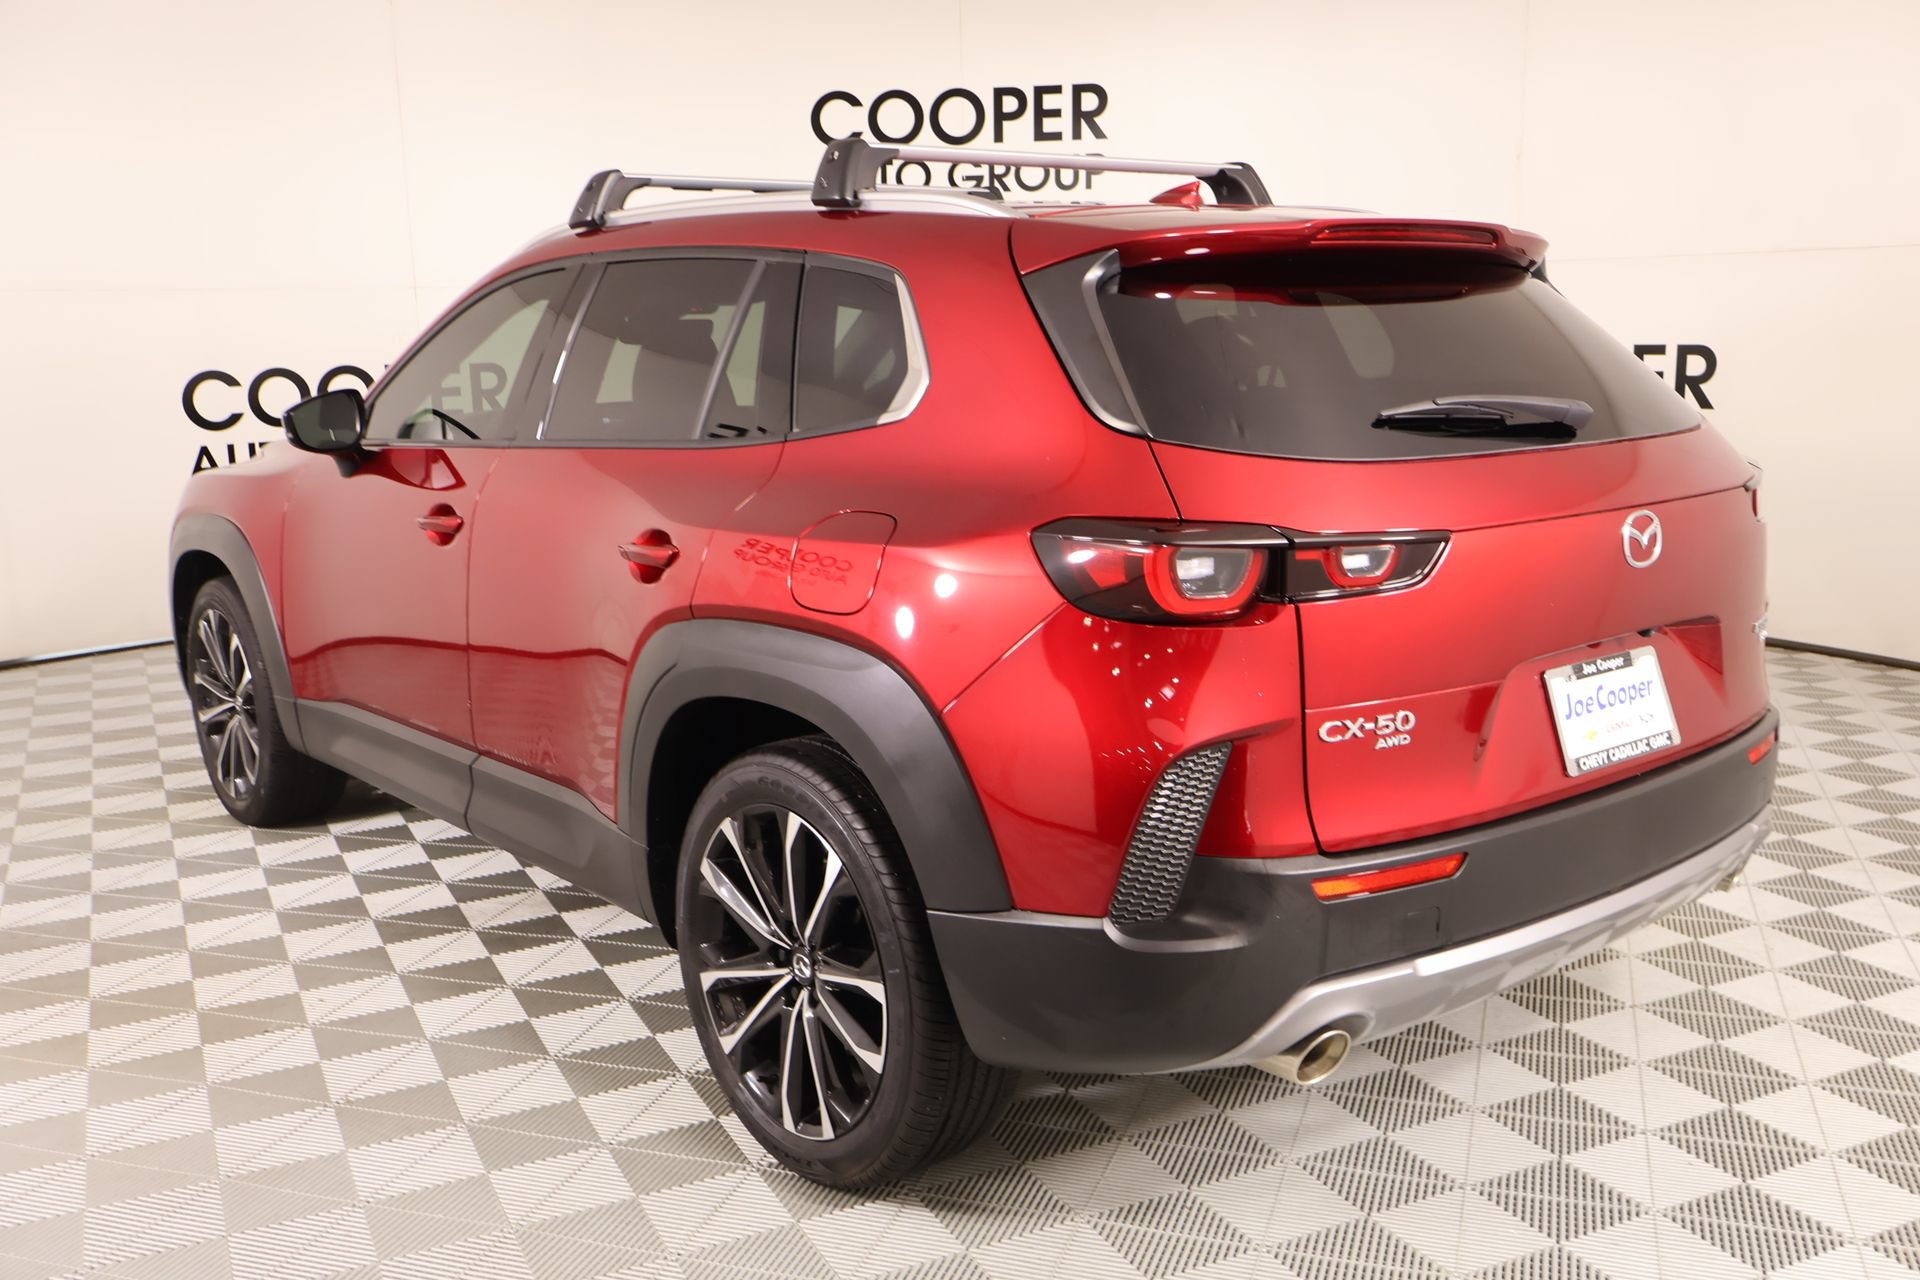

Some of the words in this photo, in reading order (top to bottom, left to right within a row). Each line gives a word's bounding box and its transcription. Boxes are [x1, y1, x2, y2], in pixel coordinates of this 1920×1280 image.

[811, 83, 1108, 146] COOPER
[1318, 709, 1416, 743] CX-50
[1374, 733, 1411, 750] AWD
[1579, 752, 1610, 771] CHEVY
[1608, 738, 1650, 762] CADILLAC
[1649, 731, 1671, 749] GMC
